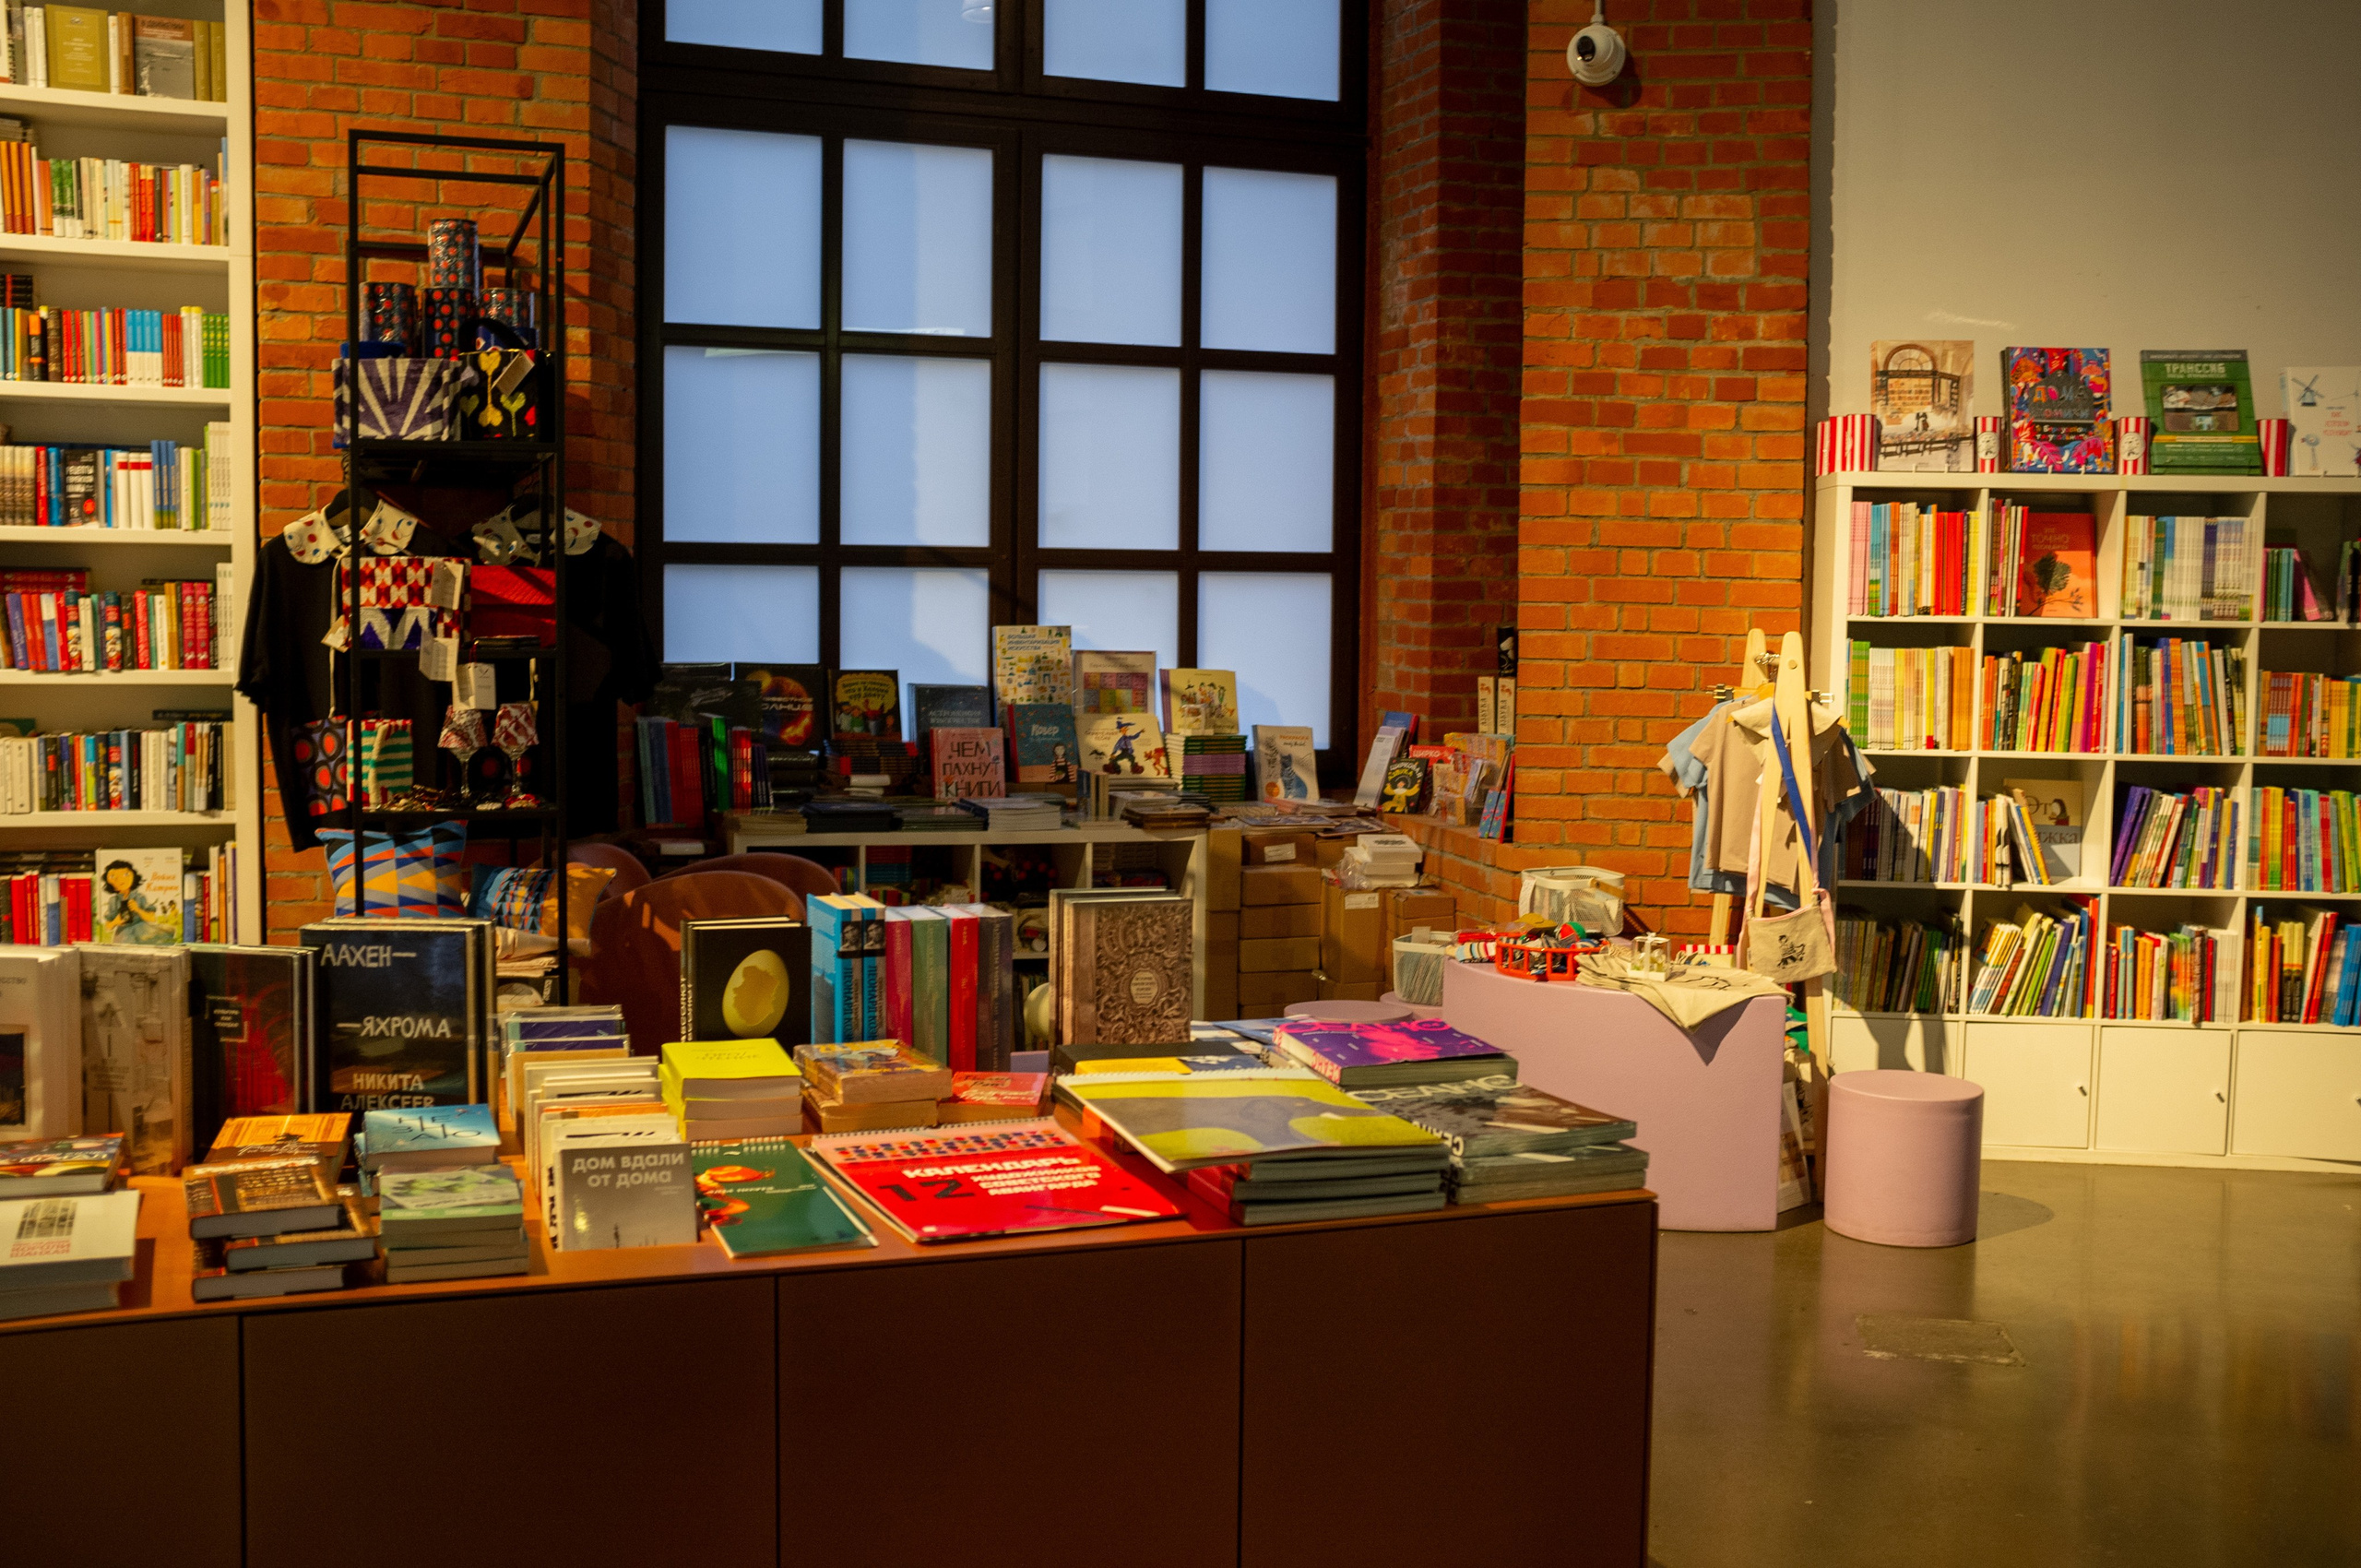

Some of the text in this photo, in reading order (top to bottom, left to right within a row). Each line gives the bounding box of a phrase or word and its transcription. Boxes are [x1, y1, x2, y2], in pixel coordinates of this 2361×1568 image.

[2165, 363, 2226, 374] ТРАНССИБ
[951, 742, 991, 756] ЧЕМ
[943, 762, 1000, 777] ПАХНУТ
[944, 780, 1001, 797] КНИГИ
[352, 1073, 425, 1091] НИКИТА
[1347, 1075, 1522, 1102] СЕАНС
[340, 1094, 436, 1111] АЛЕКСЕЕВ
[902, 1157, 1082, 1179] КАЛЕНДАРЬ
[970, 1165, 1102, 1182] ХУДОЖНИКОВ
[979, 1171, 1102, 1189] СОВЕТСКОГО
[988, 1180, 1098, 1196] АВАНГАРДА
[879, 1179, 977, 1202] 12
